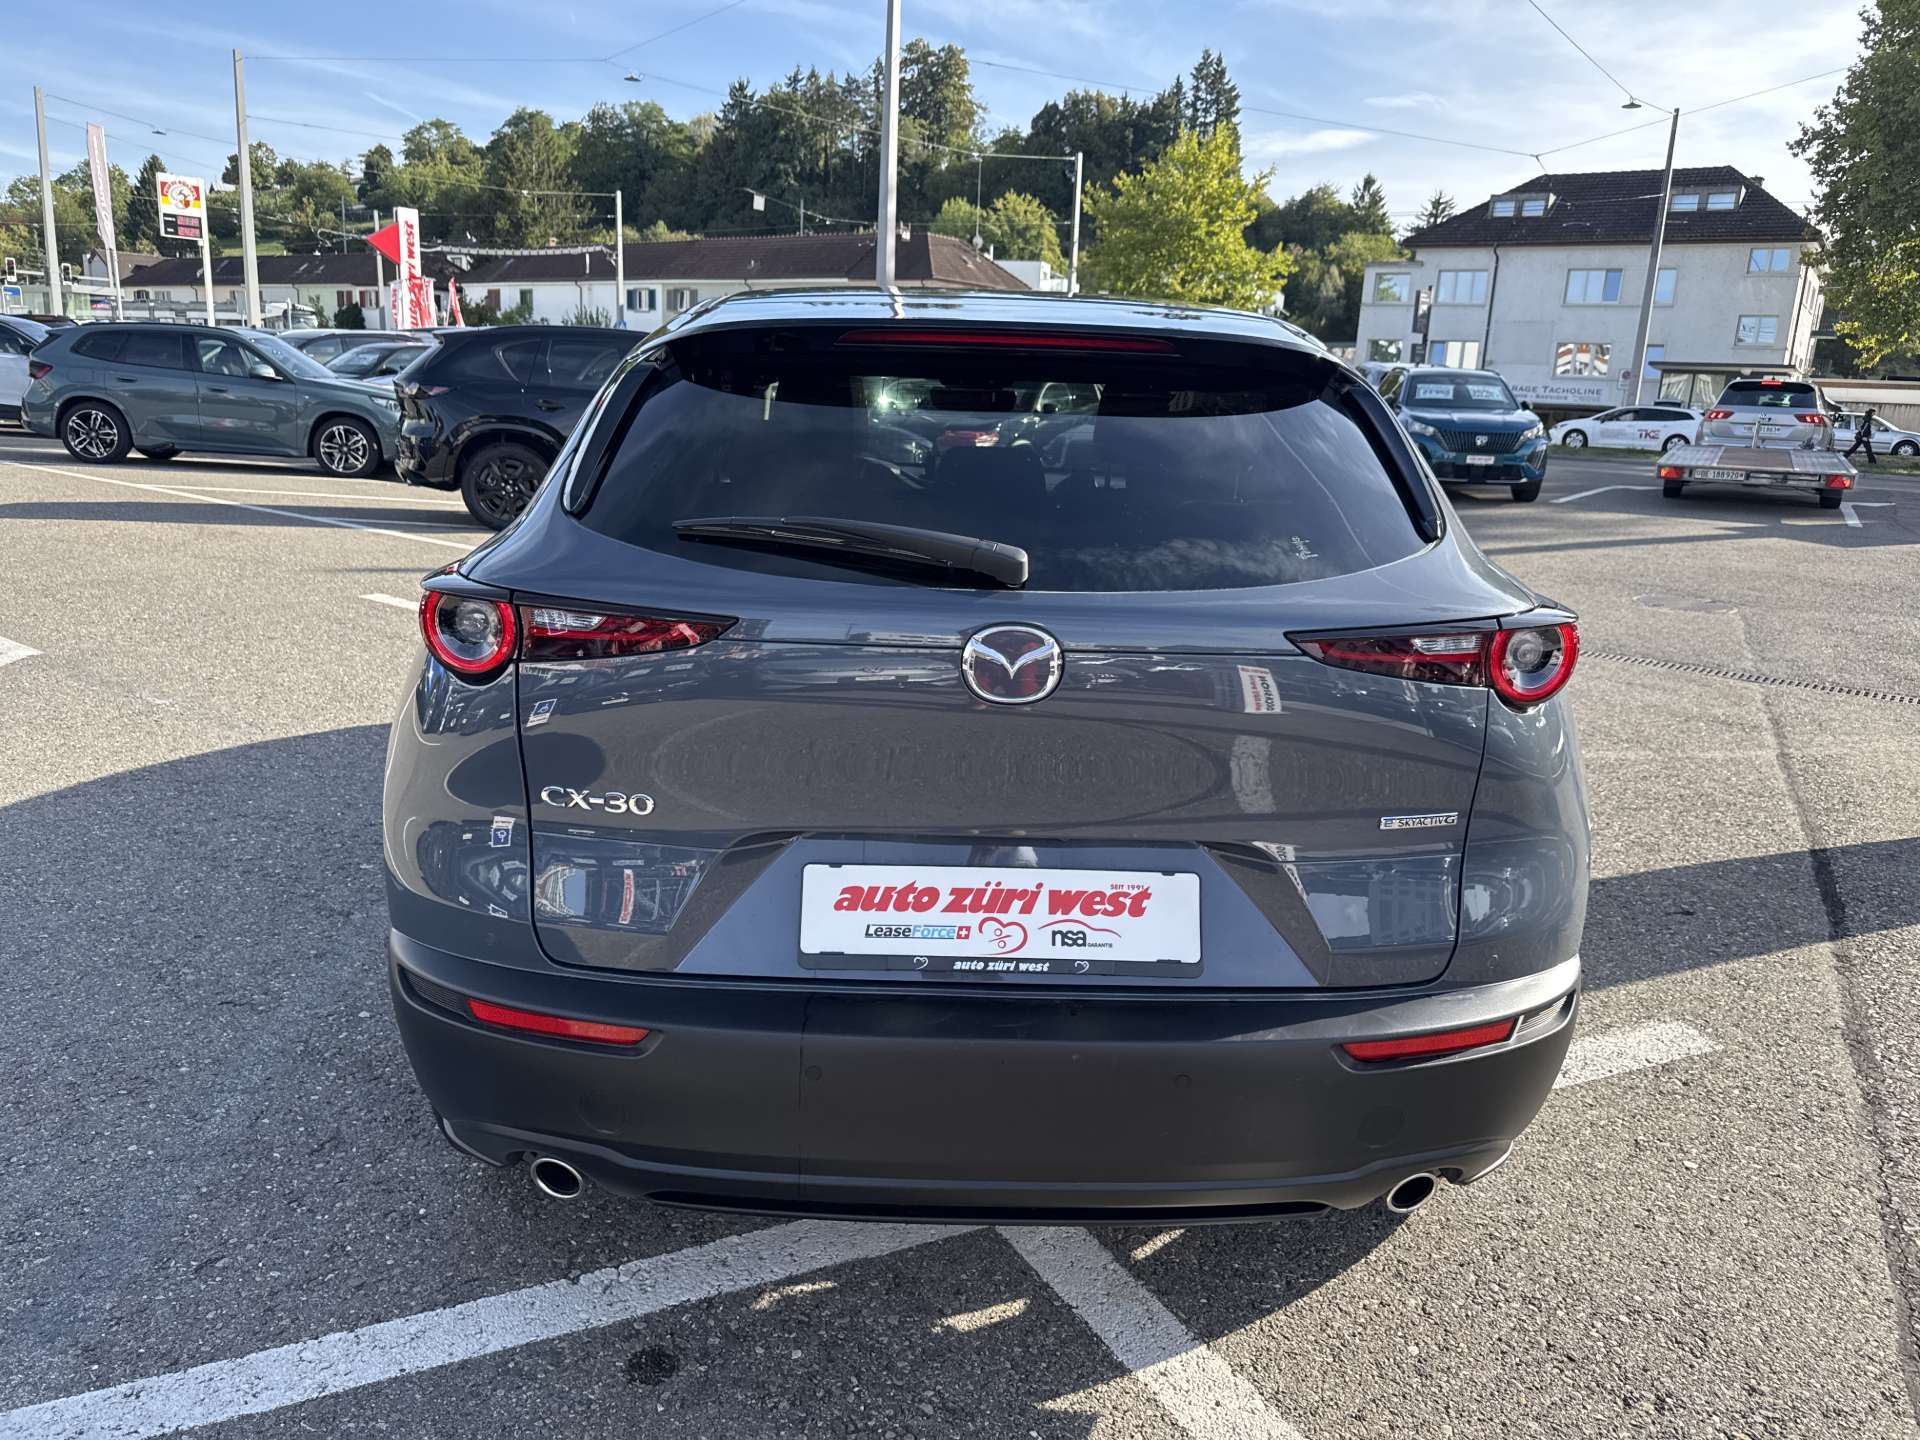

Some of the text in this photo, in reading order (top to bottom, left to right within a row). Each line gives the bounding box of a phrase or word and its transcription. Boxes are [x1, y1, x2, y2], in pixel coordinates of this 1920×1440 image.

[405, 221, 415, 259] west
[1637, 429, 1661, 439] TKE
[540, 785, 655, 816] CX-30
[833, 880, 1152, 918] auto züri west
[864, 924, 956, 939] LeaseForce
[1051, 929, 1087, 948] nsa
[953, 960, 1050, 972] auto züri west
